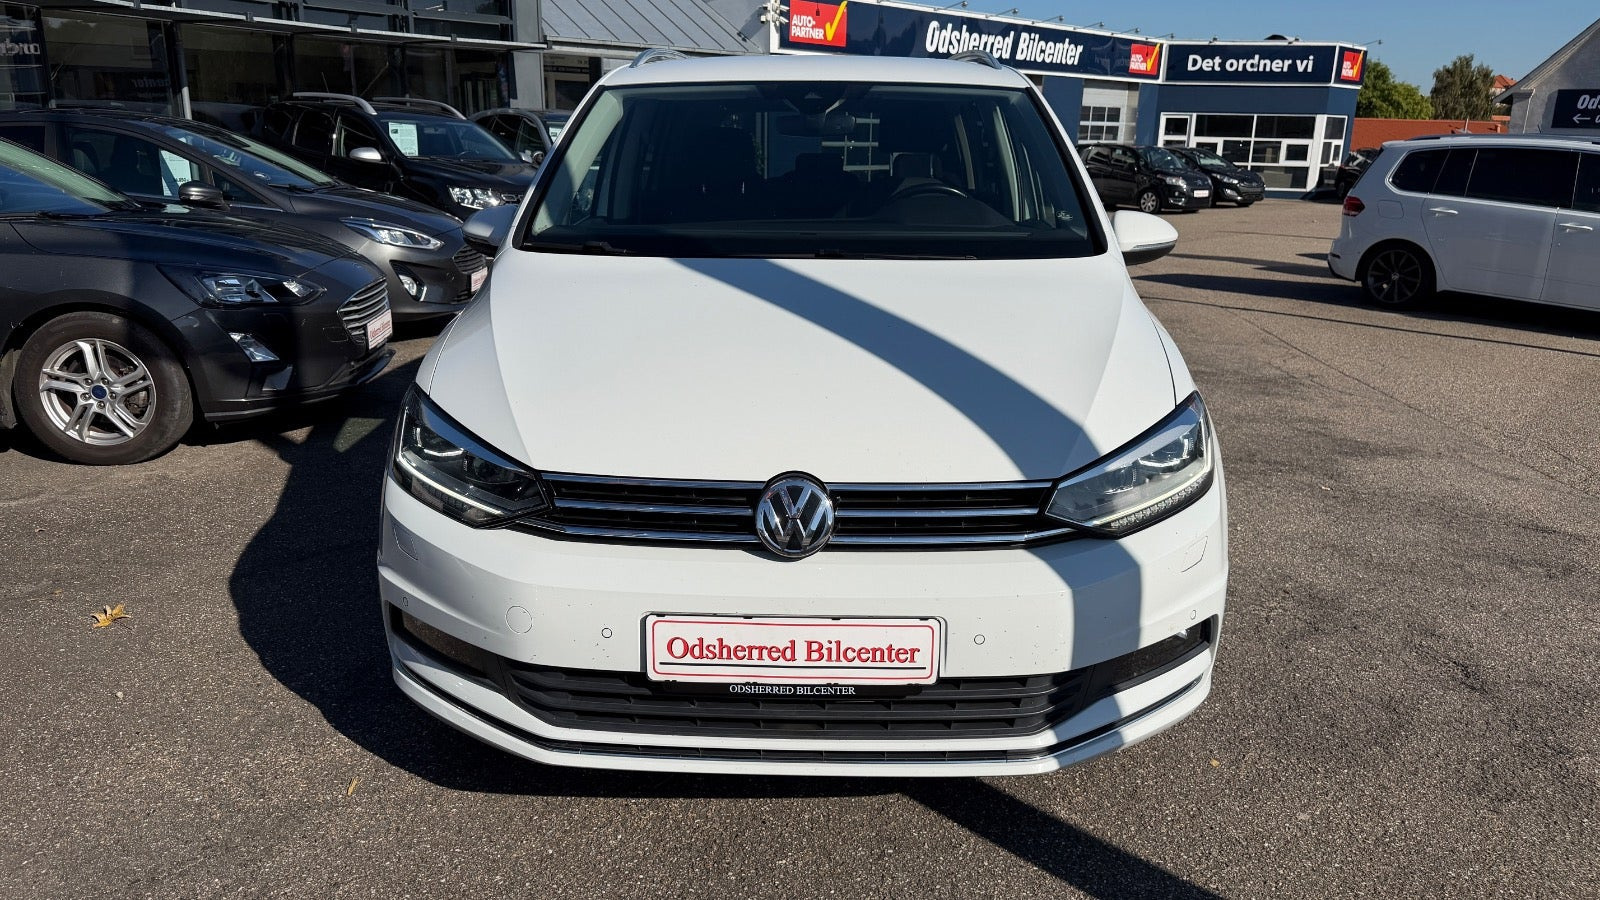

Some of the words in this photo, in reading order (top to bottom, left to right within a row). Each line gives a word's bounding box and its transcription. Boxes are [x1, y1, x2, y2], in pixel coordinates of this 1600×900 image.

[791, 14, 816, 27] AUTO-
[791, 25, 825, 40] PARTNER
[925, 20, 1015, 59] Odsherred
[1015, 31, 1084, 66] Bilcenter
[1187, 54, 1222, 72] Det
[1225, 54, 1293, 73] ordner
[1296, 55, 1314, 73] vi
[666, 636, 797, 662] Odsherred
[805, 639, 921, 664] Bilcenter
[729, 684, 794, 695] ODSHERRED
[796, 686, 856, 695] BILCENTER
